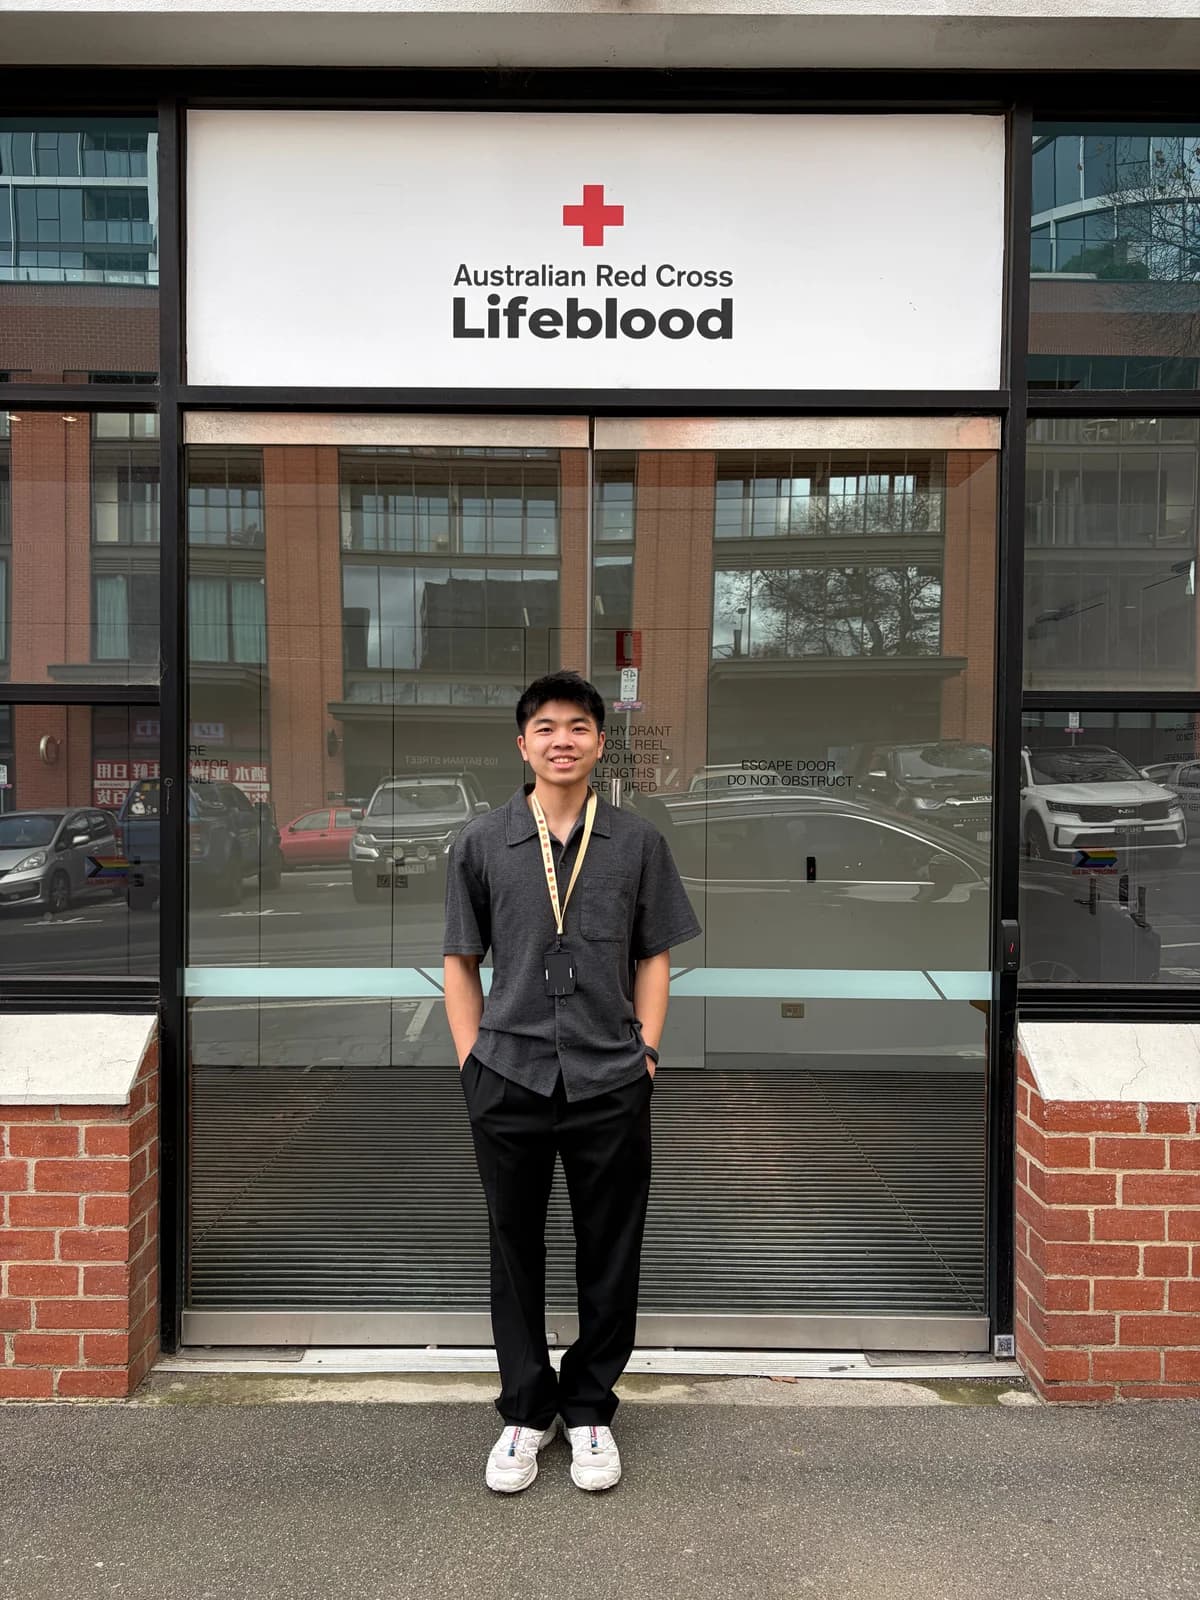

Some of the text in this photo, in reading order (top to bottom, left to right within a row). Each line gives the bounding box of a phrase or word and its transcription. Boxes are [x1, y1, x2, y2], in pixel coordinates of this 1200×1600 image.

[453, 264, 734, 288] Australian Red Cross
[453, 293, 734, 340] Lifeblood
[610, 725, 672, 737] HYDRANT
[603, 739, 666, 751] OSE REEL
[599, 753, 660, 765] WO HOSE
[741, 760, 836, 771] ESCAPE DOOR
[594, 767, 655, 778] LENGTHS
[727, 775, 854, 786] DO NOT OBSTRUCT
